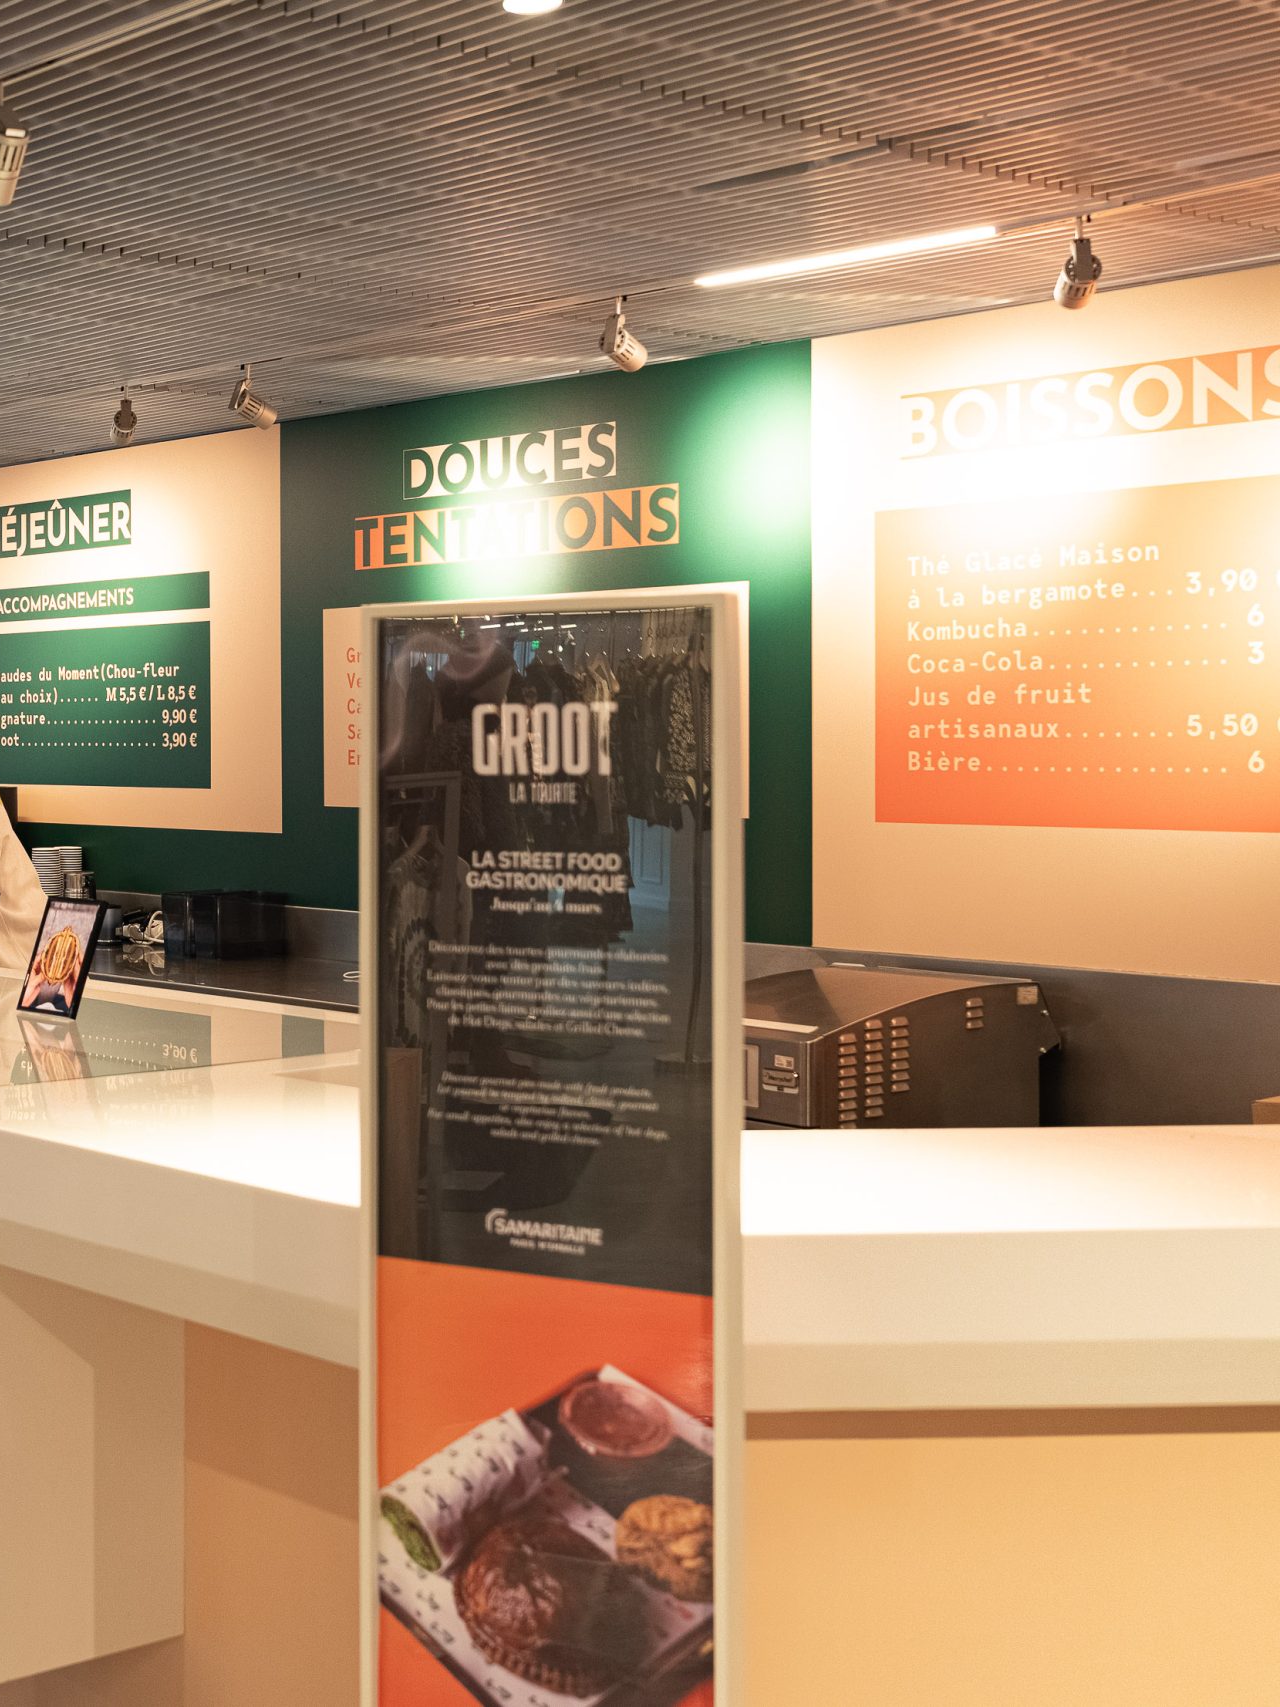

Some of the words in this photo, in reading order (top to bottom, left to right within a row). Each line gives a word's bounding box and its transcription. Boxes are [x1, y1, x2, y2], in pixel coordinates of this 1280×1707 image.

[408, 422, 616, 499] DOUCES
[356, 485, 678, 567] TENTATIONS
[1060, 543, 1159, 567] Maison
[908, 588, 921, 610] à
[938, 587, 965, 607] la
[982, 579, 1125, 610] bergamote
[1186, 569, 1258, 600] 3,90
[908, 619, 1026, 642] Kombucha
[1247, 604, 1265, 627] 6
[908, 650, 1043, 674] Coca-Cola
[1248, 641, 1264, 664] 3
[39, 667, 52, 681] du
[0, 692, 13, 704] au
[106, 687, 117, 701] M
[119, 686, 136, 704] 5,5
[139, 688, 146, 700] €
[157, 686, 165, 700] L
[168, 685, 186, 703] 8,5
[188, 686, 196, 699] €
[908, 685, 950, 707] Jus
[967, 686, 996, 706] de
[1014, 683, 1092, 704] fruit
[162, 709, 187, 727] 9,90
[189, 710, 197, 724] €
[908, 717, 1059, 740] artisanaux
[1187, 714, 1259, 741] 5,50
[162, 733, 187, 750] 3,90
[189, 734, 197, 747] €
[472, 701, 618, 777] GROOT
[908, 750, 981, 772] Bière
[1248, 750, 1265, 773] 6
[509, 782, 527, 803] LA
[471, 851, 495, 869] LA
[498, 852, 565, 870] STREET
[569, 853, 621, 872] FOOD
[466, 871, 628, 895] GASTRONOMIQUE
[494, 1218, 603, 1246] SAMARITAINE
